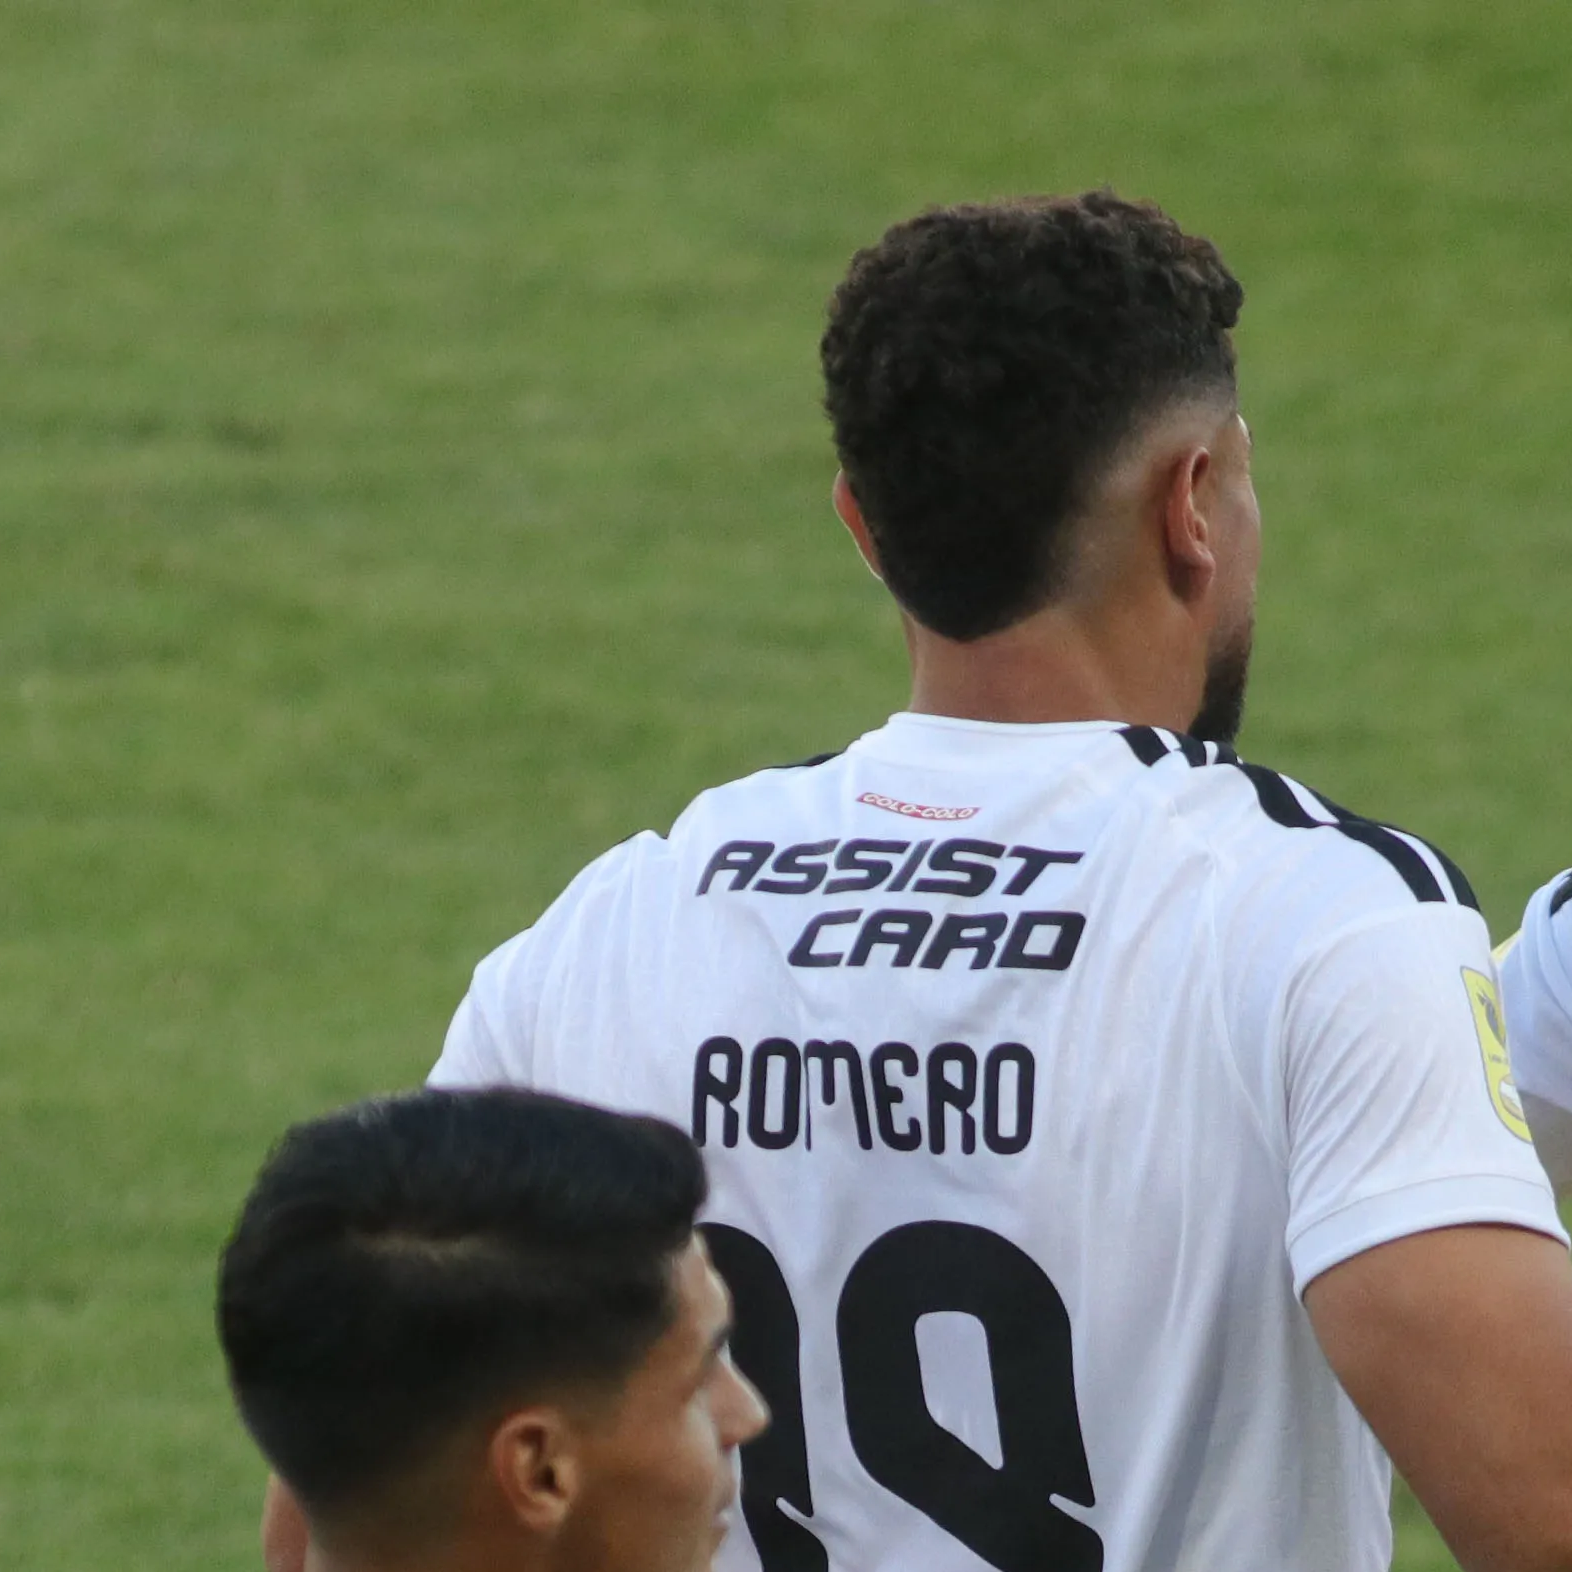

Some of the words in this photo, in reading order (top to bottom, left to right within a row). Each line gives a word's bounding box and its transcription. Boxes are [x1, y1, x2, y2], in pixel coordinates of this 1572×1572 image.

[861, 792, 975, 819] COLO-COLO
[695, 838, 1084, 897] ASSIST
[788, 909, 1087, 971] CARD
[692, 1035, 1035, 1155] ROMERO
